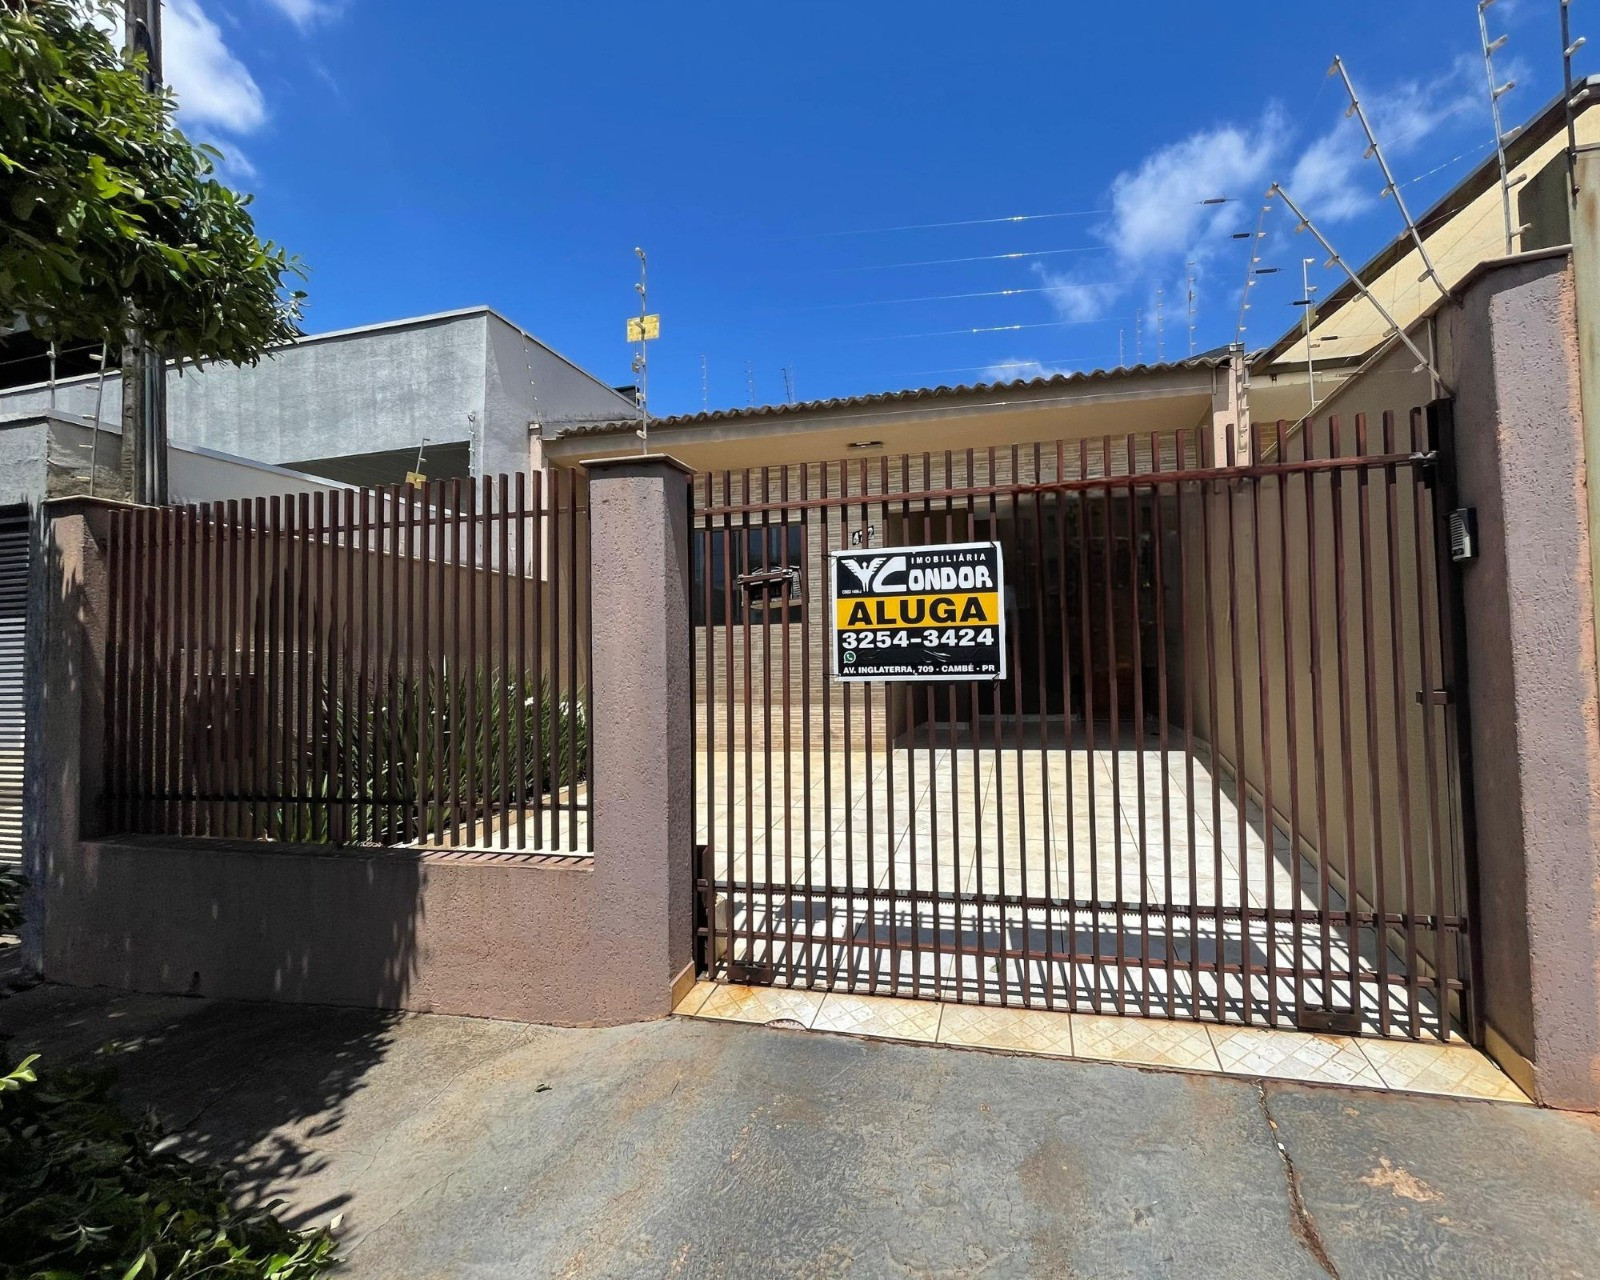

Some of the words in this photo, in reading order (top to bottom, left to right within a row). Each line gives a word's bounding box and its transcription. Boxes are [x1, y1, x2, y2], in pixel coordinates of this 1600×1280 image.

[911, 553, 986, 564] IMOBILIÁRIA
[872, 556, 993, 593] CONDOR
[847, 597, 988, 626] ALUGA
[842, 628, 994, 649] 3254-3424
[843, 666, 856, 674] AV.
[858, 665, 916, 674] INGLATERRA,
[917, 665, 934, 673] 709
[941, 662, 974, 673] CAMBÉ
[982, 664, 995, 672] PR
